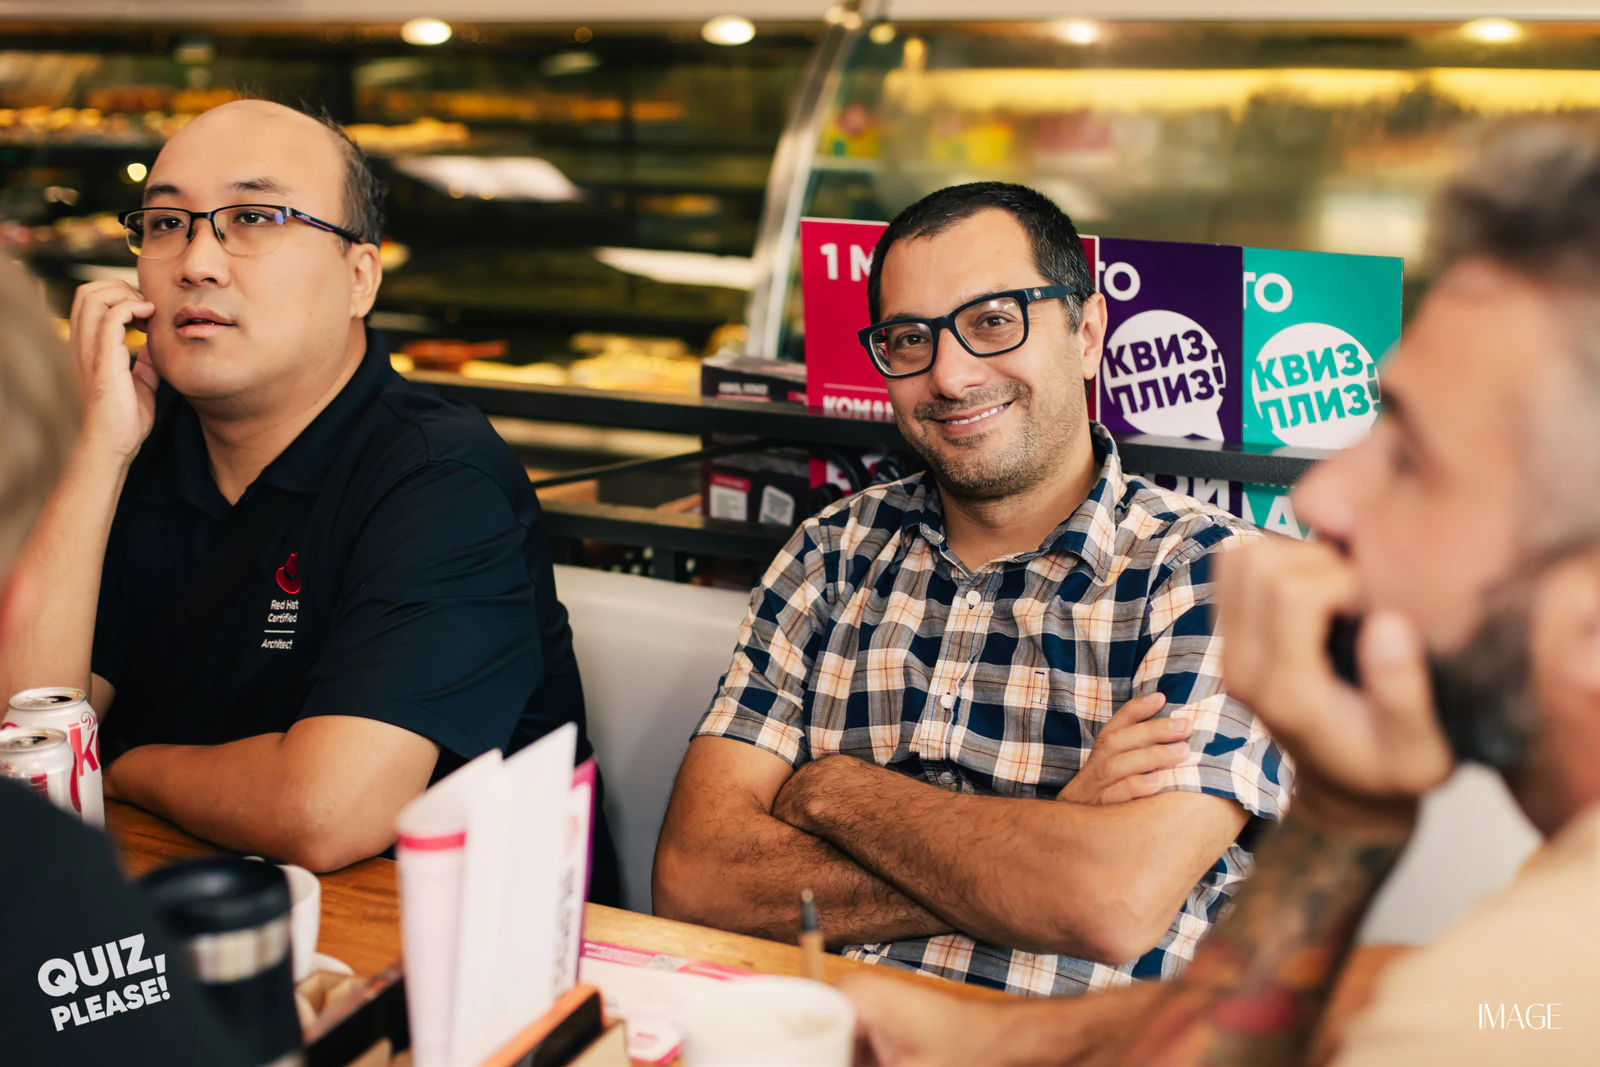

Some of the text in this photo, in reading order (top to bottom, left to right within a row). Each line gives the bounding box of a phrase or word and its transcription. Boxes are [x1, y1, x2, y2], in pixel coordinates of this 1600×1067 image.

[820, 242, 838, 280] 1
[1099, 261, 1141, 301] О
[1104, 329, 1219, 379] КВИЗ,
[1110, 366, 1225, 414] ПЛИЗ!
[267, 612, 298, 623] Certified
[270, 599, 299, 610] Red Hat
[261, 638, 293, 650] Architect
